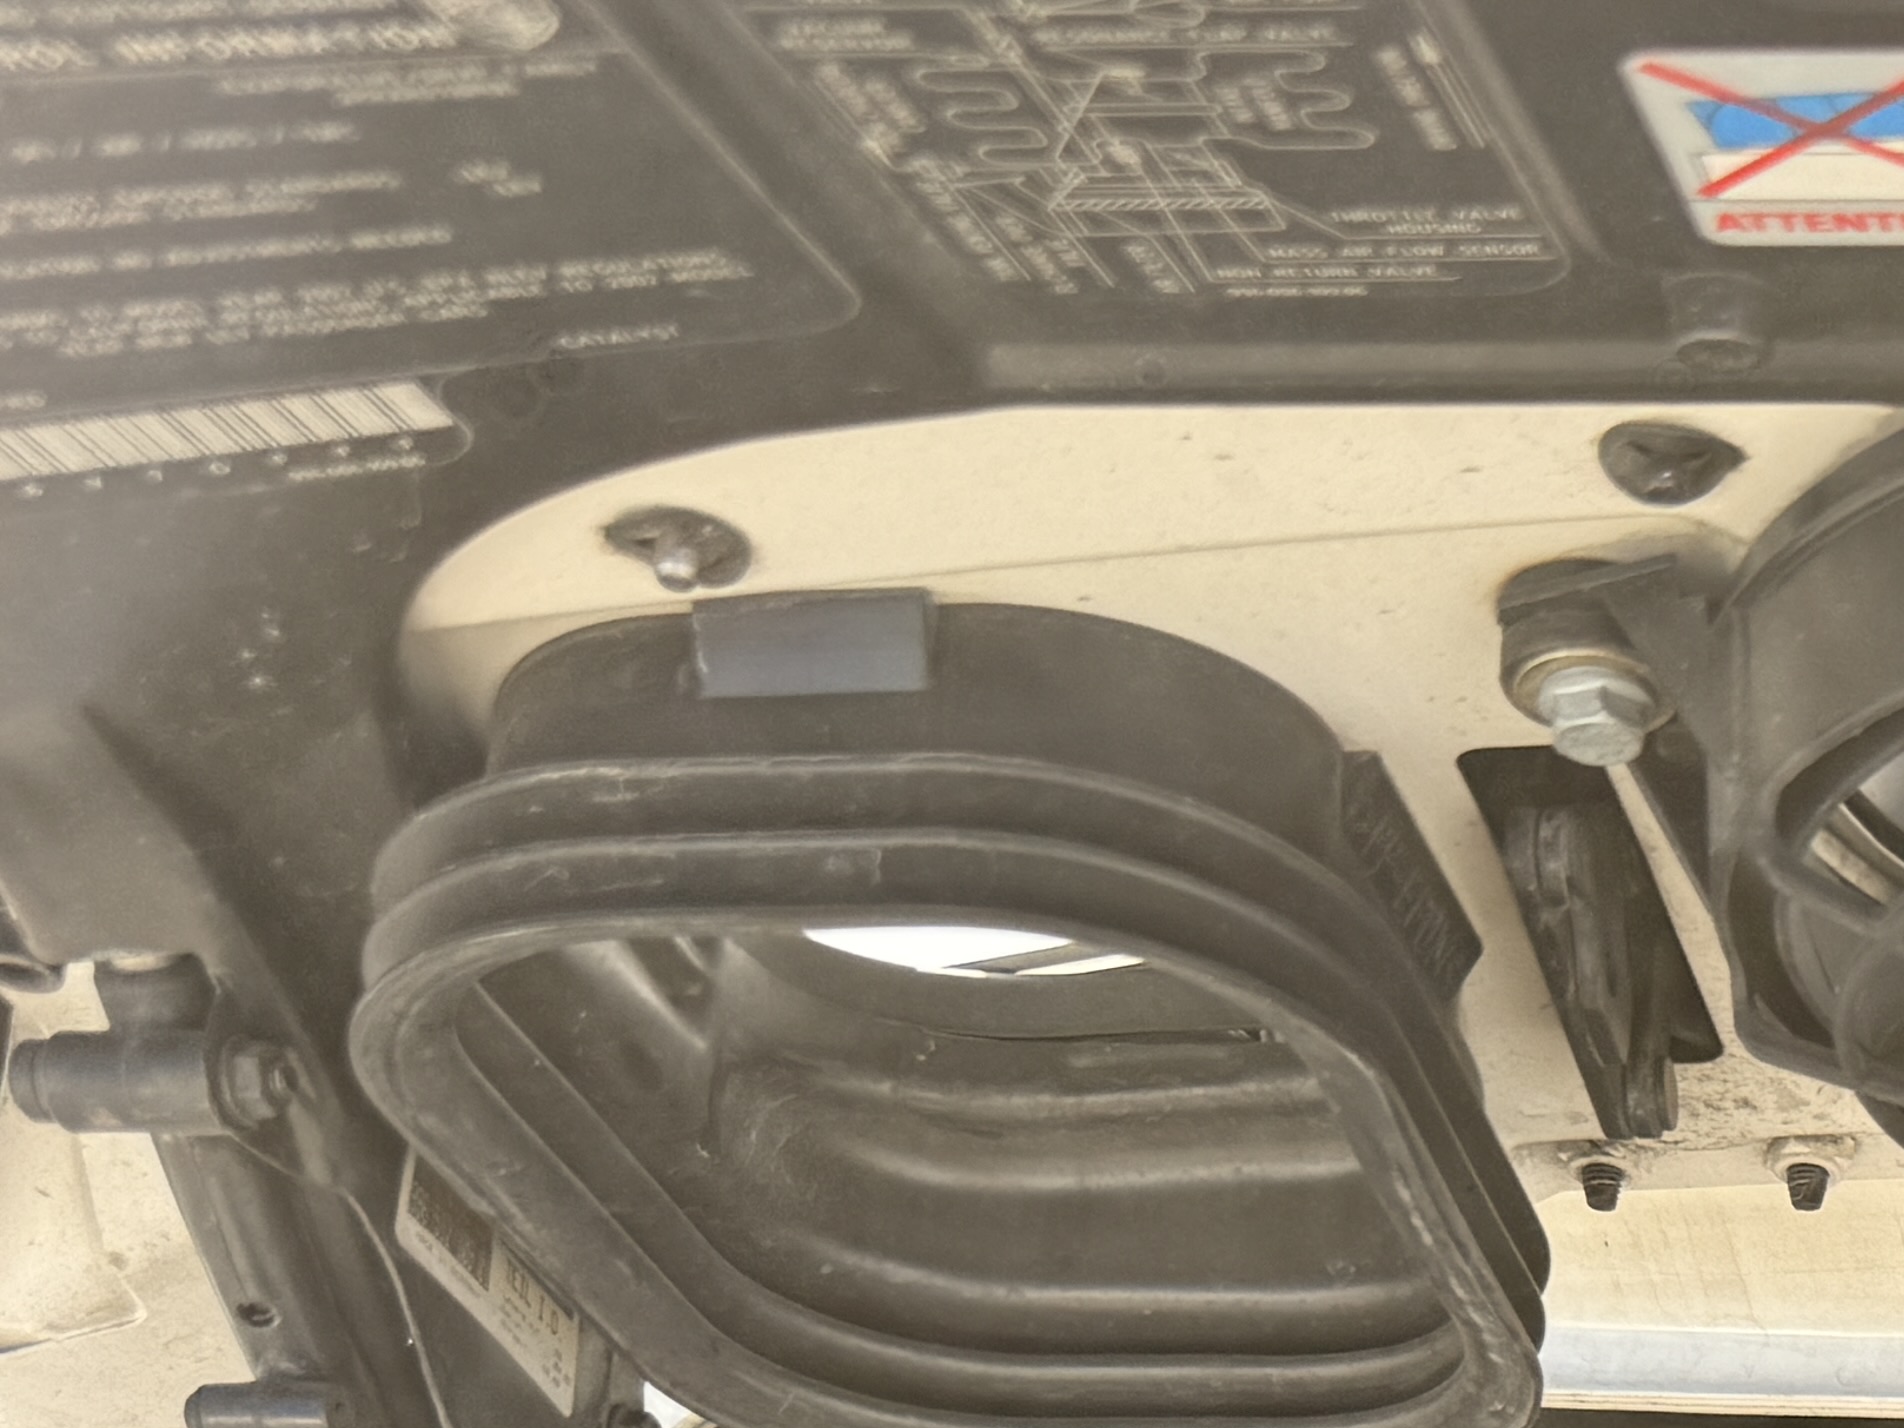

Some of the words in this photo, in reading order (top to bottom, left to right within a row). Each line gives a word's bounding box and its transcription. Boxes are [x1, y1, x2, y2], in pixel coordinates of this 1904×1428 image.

[1330, 208, 1439, 224] THROTTLE
[1452, 206, 1522, 222] VALVE
[1383, 223, 1483, 235] HOUSING
[1266, 245, 1329, 259] MASS
[1338, 245, 1374, 258] AIR
[1384, 244, 1446, 258] FLOW
[1457, 243, 1542, 257] SENSOR
[1216, 267, 1262, 279] NON
[1273, 266, 1359, 279] RETURN
[1367, 264, 1439, 278] VALVE
